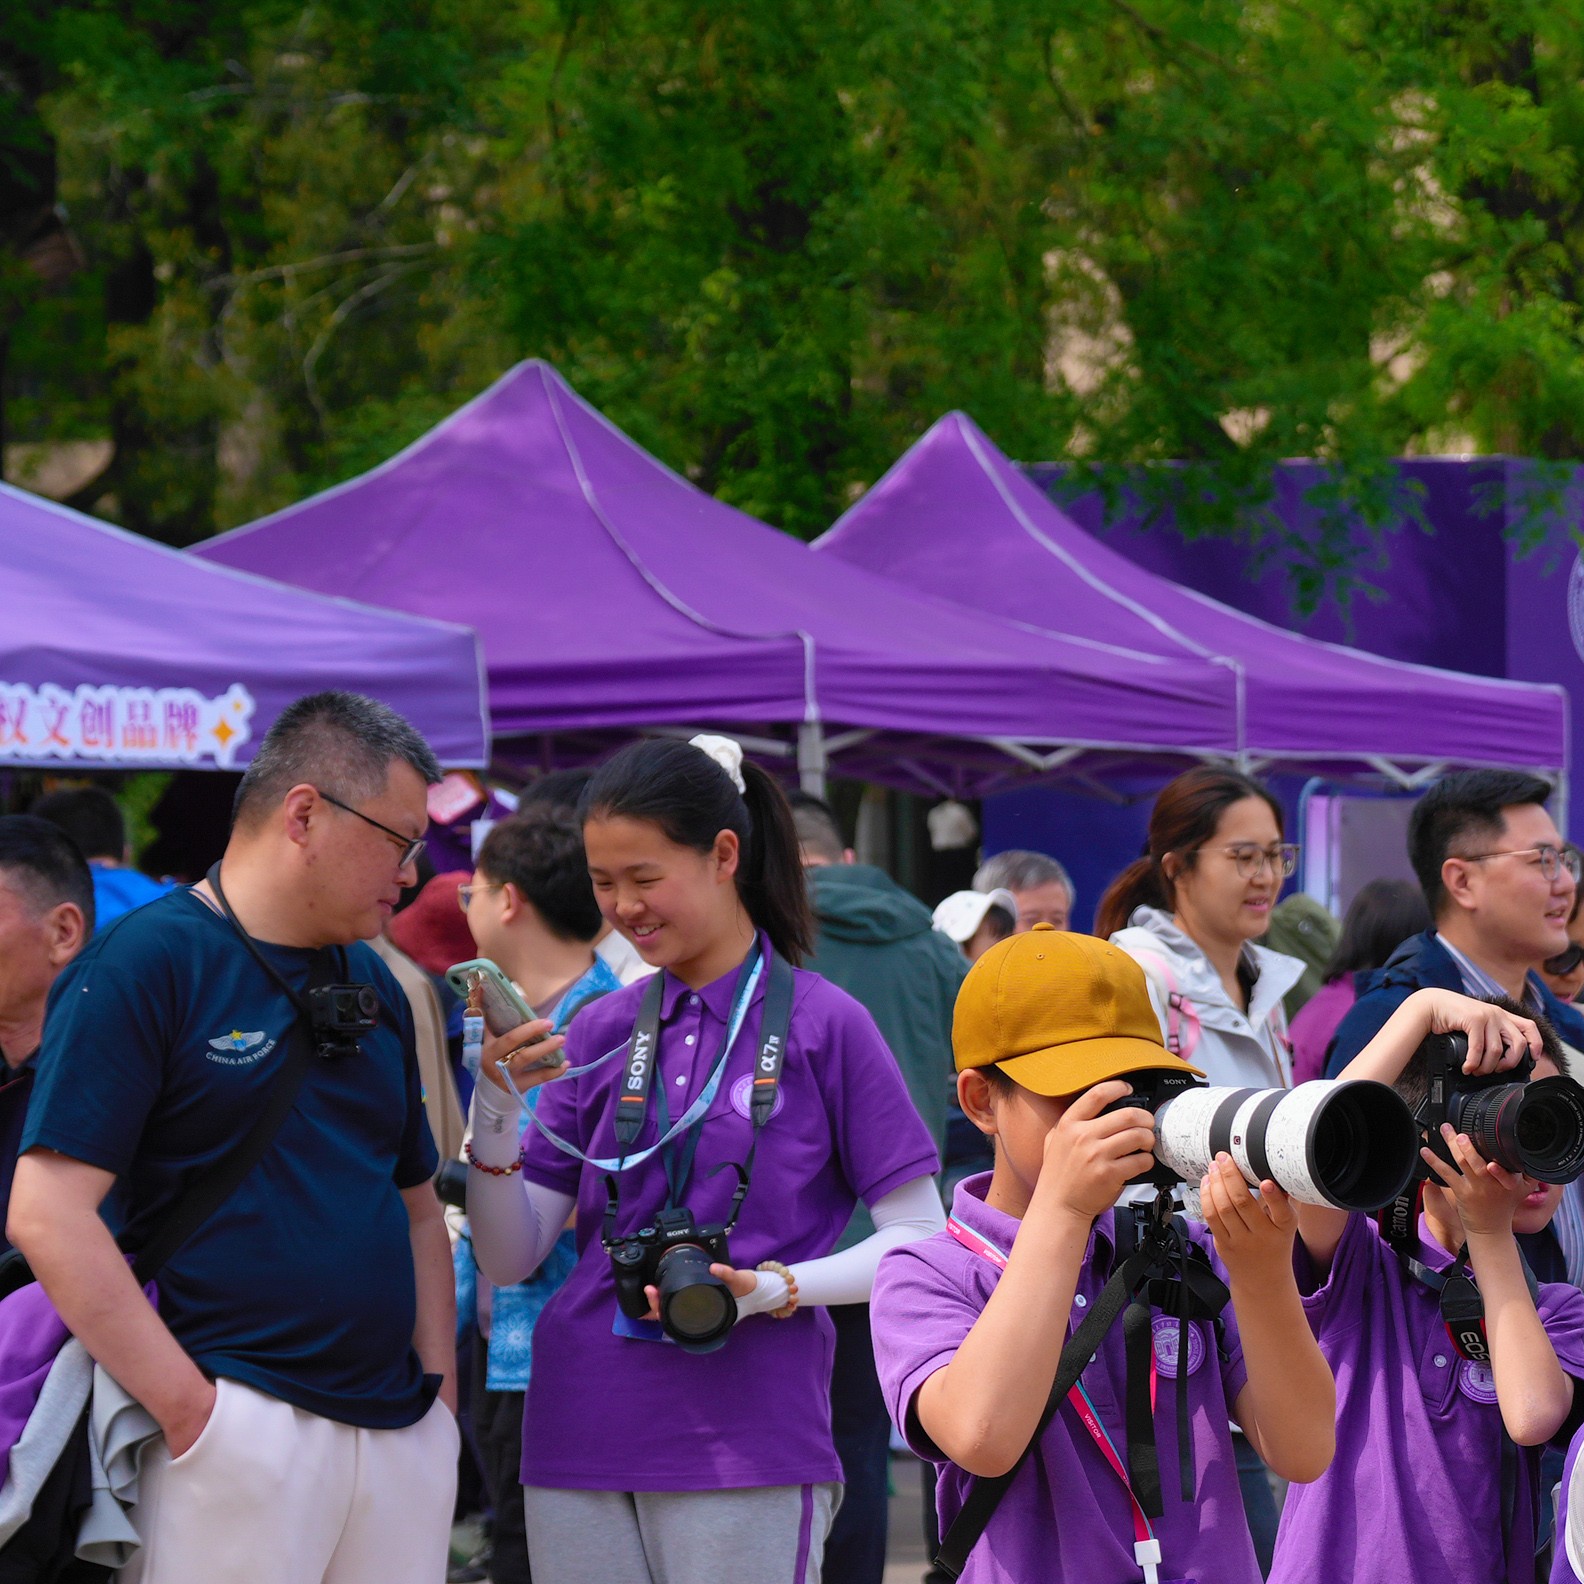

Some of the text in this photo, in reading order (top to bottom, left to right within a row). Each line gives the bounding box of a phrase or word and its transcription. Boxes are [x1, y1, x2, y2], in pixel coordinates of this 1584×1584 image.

[205, 1038, 277, 1066] CHINA AIR FORCE
[627, 1031, 650, 1090] SONY
[1163, 1078, 1187, 1086] SONY
[1390, 1196, 1410, 1239] Canon
[666, 1227, 690, 1238] SONY
[1084, 1413, 1102, 1439] VISITOR
